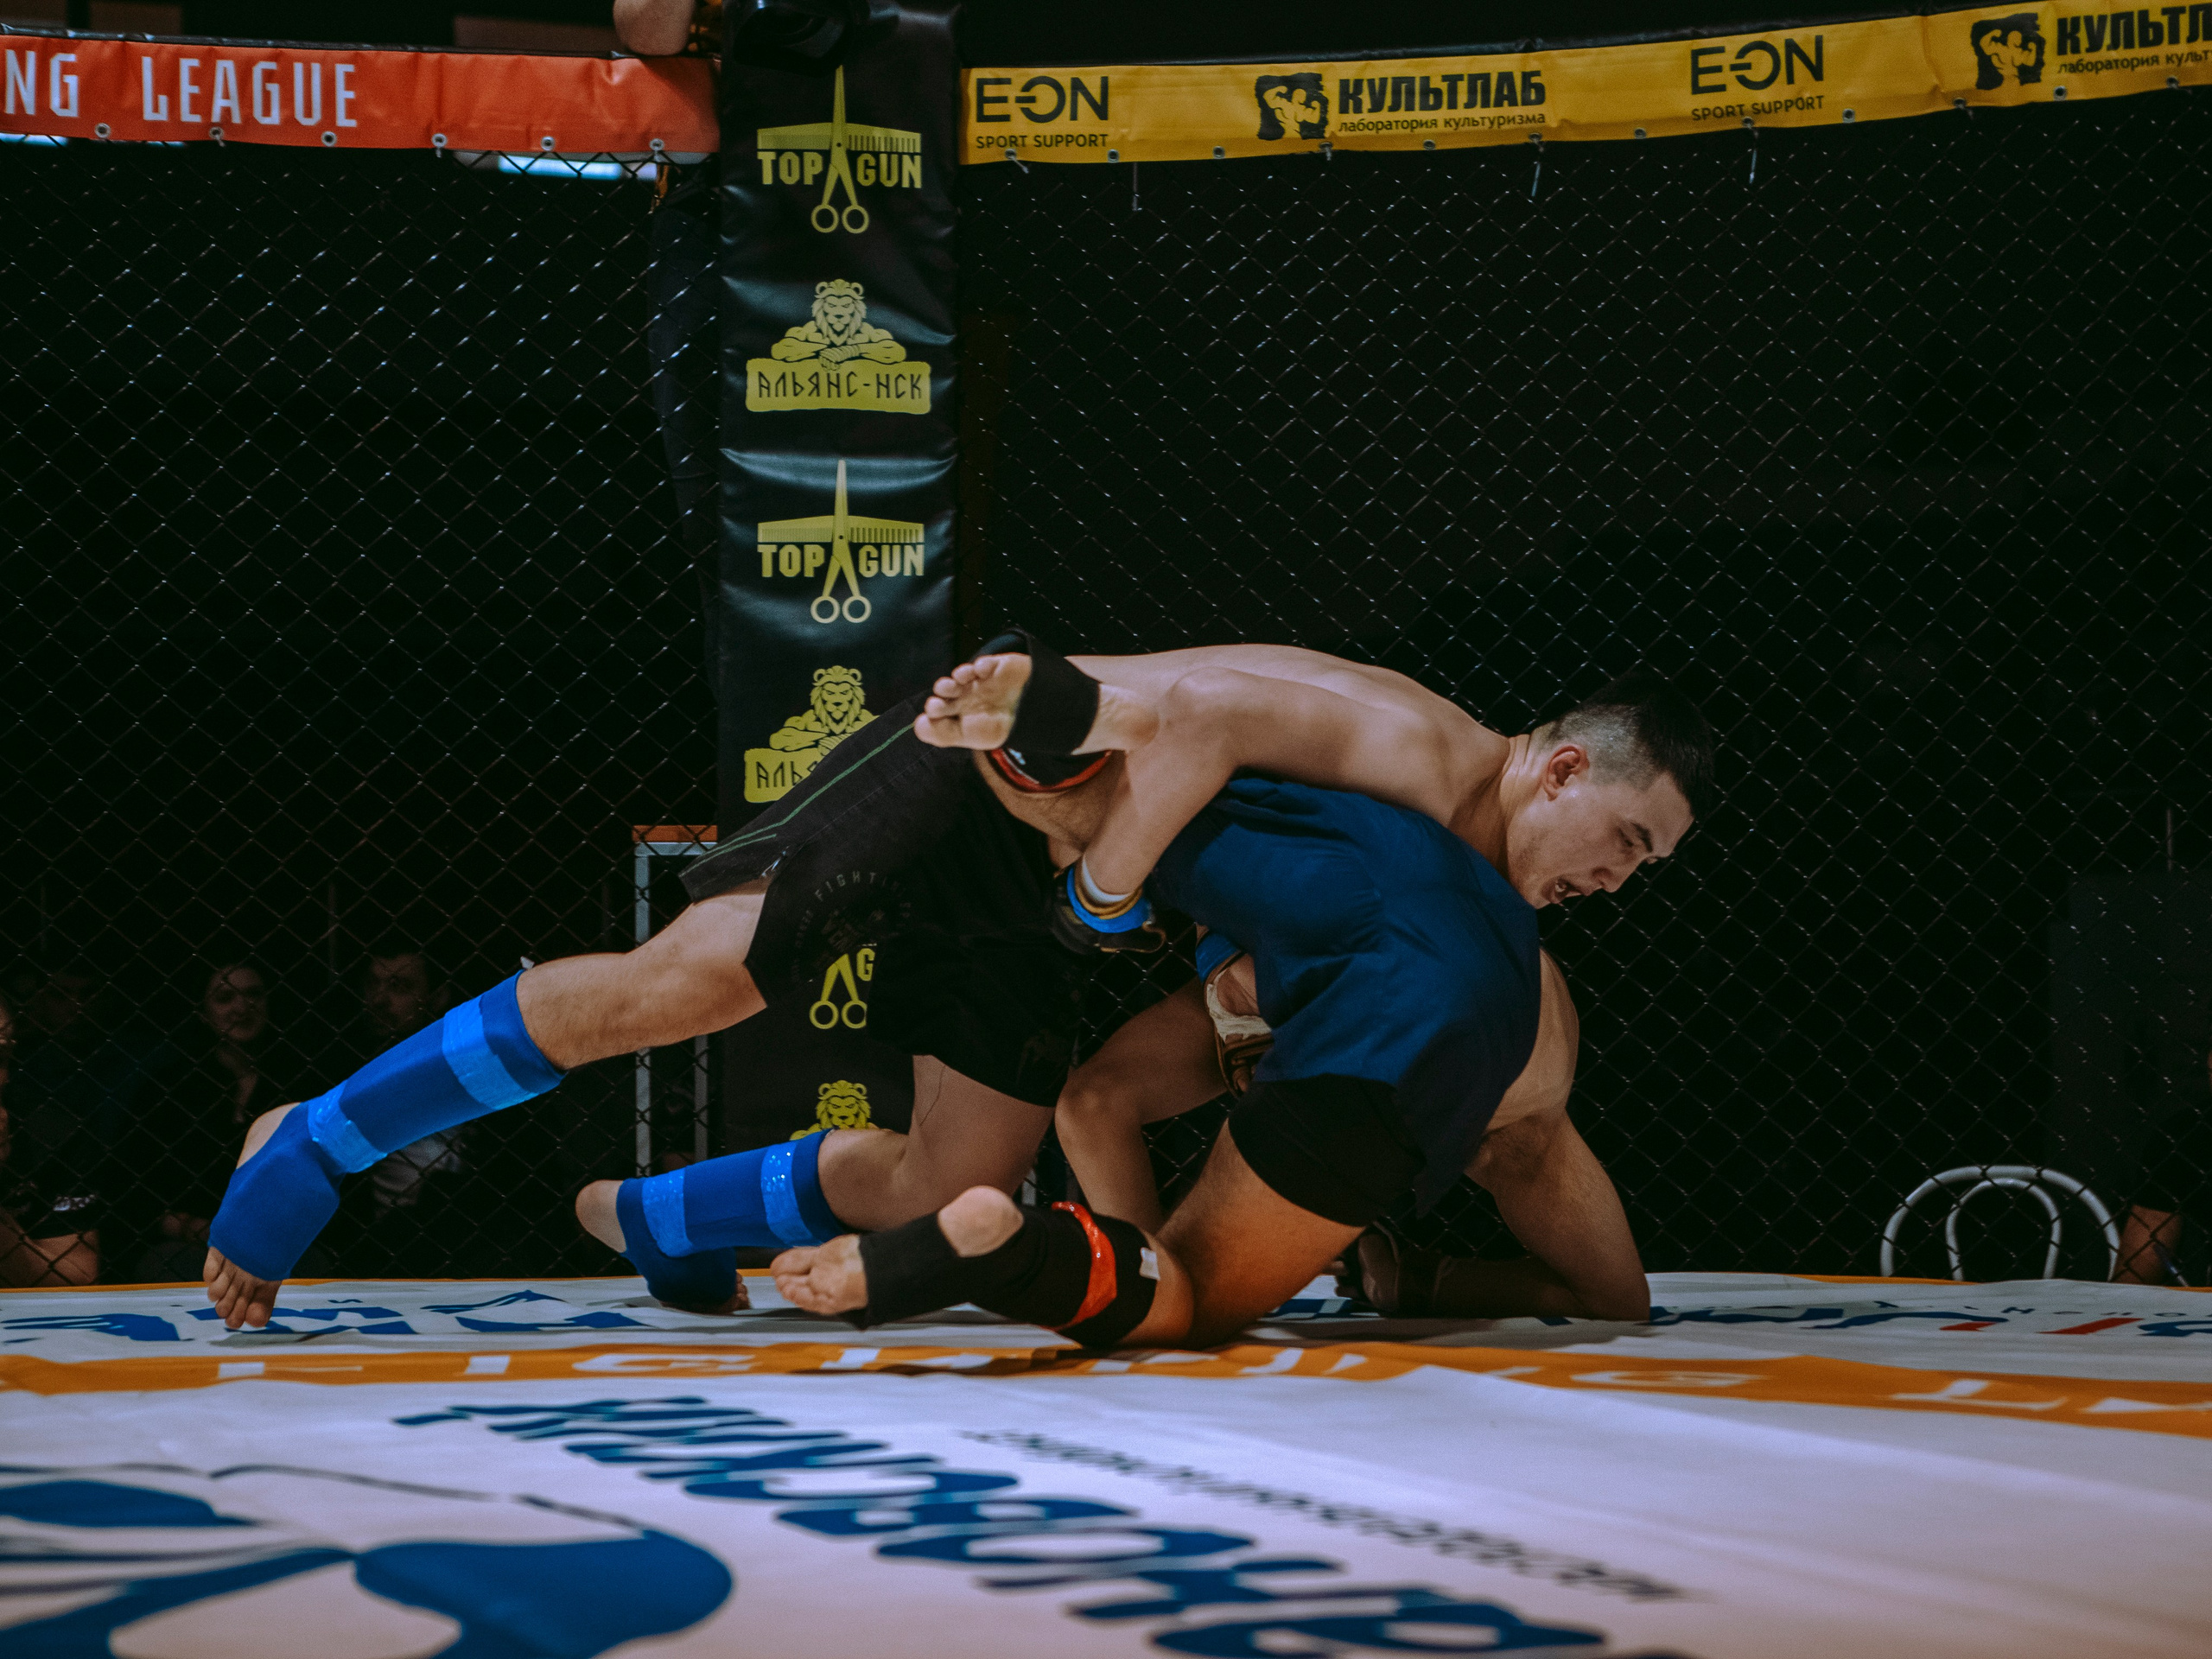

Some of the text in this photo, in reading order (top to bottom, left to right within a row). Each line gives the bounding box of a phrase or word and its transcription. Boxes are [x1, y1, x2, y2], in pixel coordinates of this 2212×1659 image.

[2057, 49, 2212, 75] лаборатория культ
[4, 49, 357, 127] NG LEAGUE
[1338, 70, 1547, 115] КУЛЬТЛАБ
[1339, 112, 1546, 134] лаборатория культуризма
[1691, 94, 1825, 122] SPORT SUPPORT
[976, 133, 1109, 149] SPORT SUPPORT
[757, 151, 923, 189] TOP GUN
[757, 370, 923, 400] АЛЬЯНС-НСК
[757, 544, 925, 578] TOP GUN
